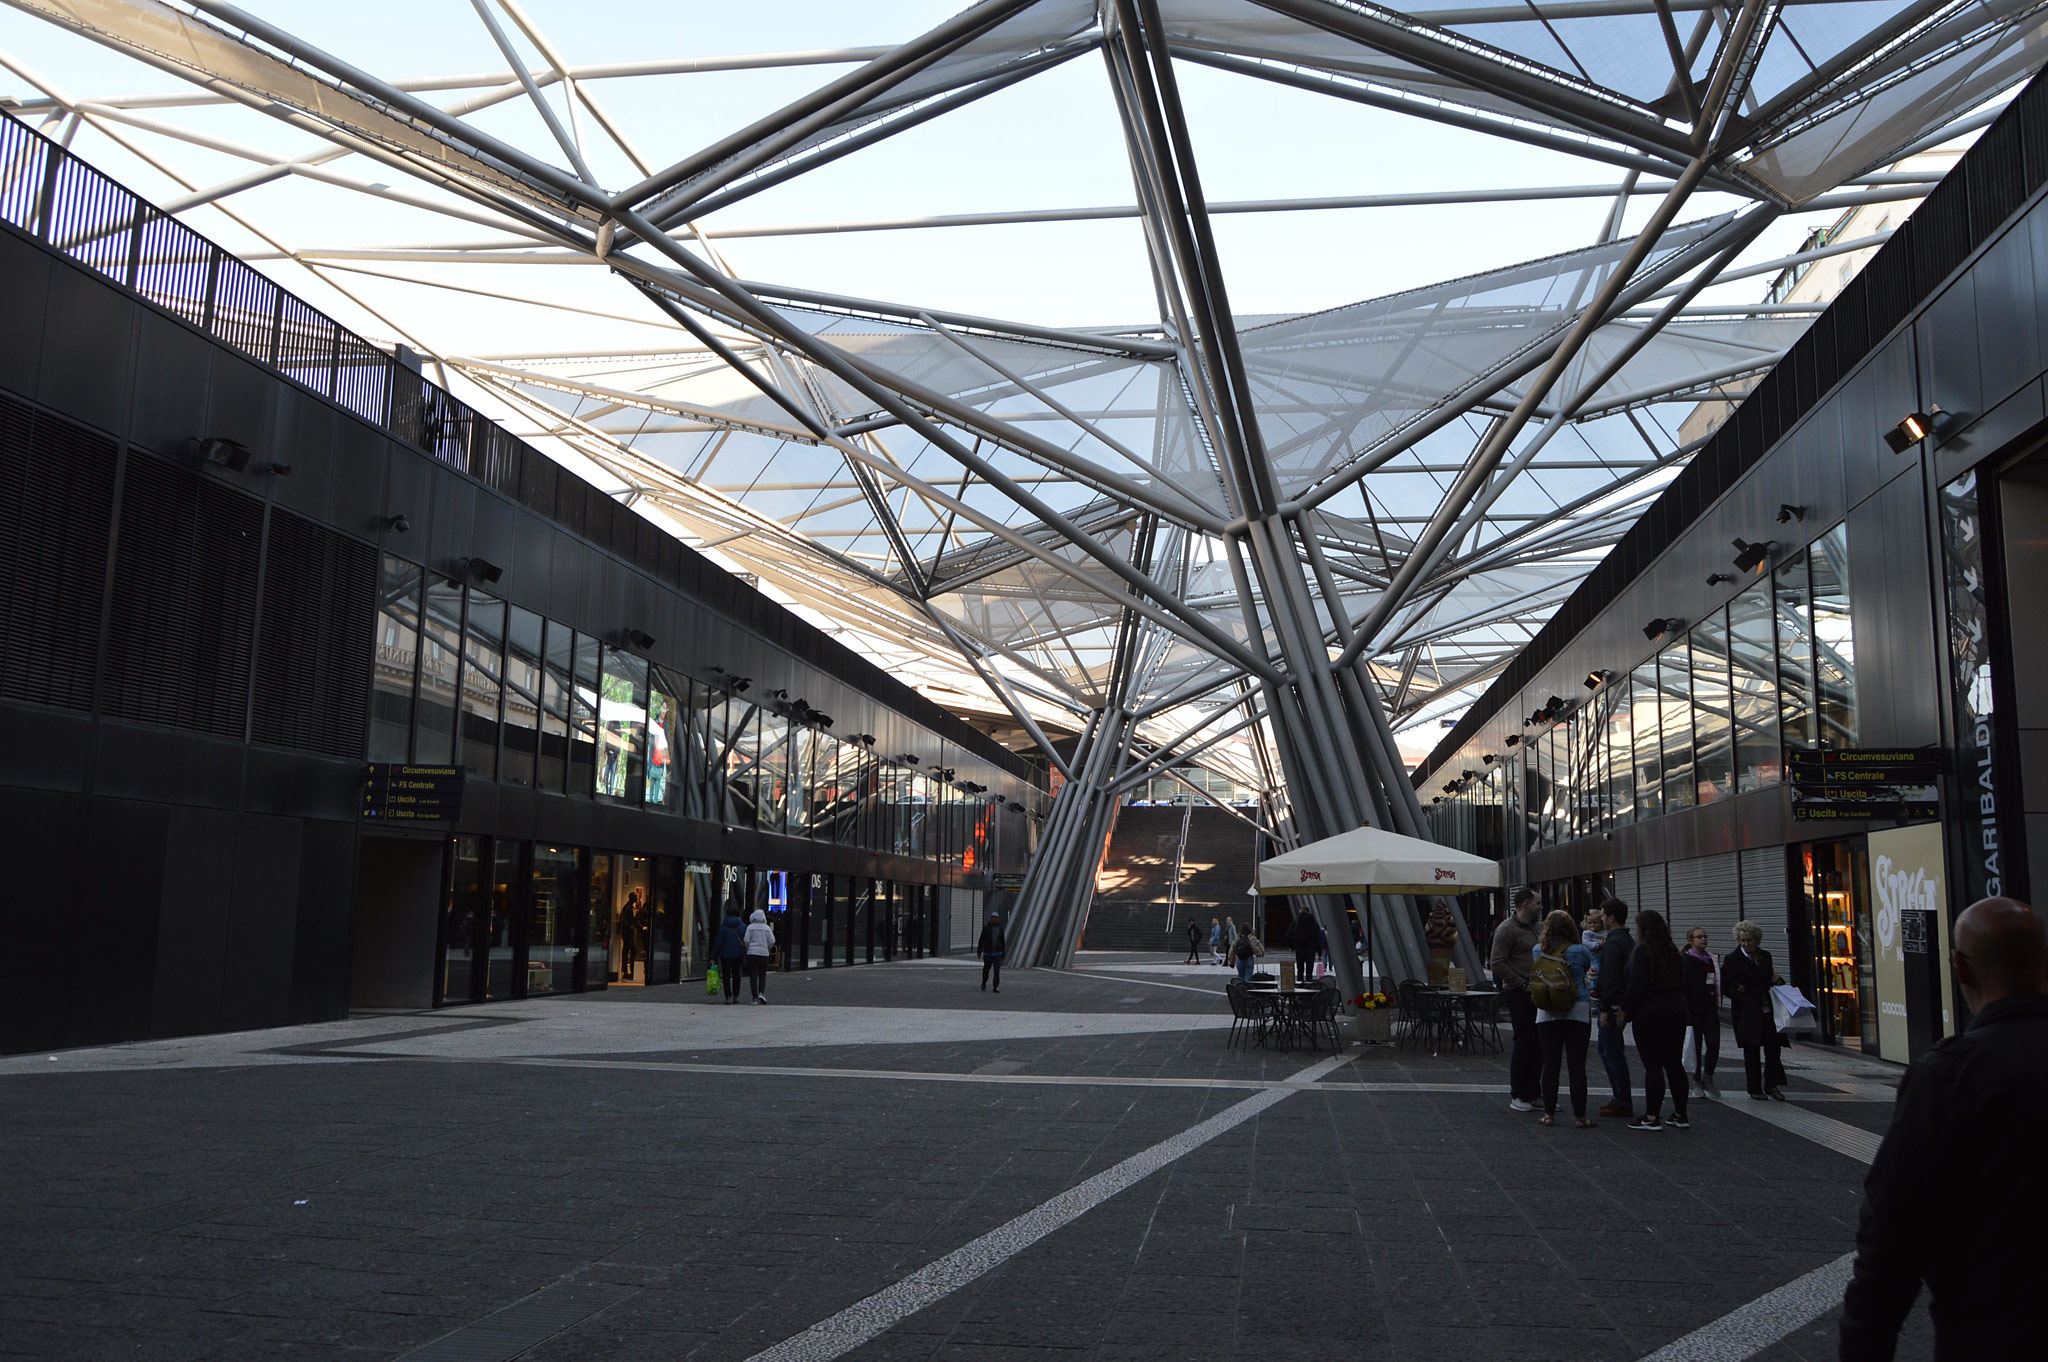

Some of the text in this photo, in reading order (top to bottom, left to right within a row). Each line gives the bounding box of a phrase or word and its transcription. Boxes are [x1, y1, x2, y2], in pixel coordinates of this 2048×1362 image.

[1839, 752, 1915, 761] Circumvesuviana
[402, 766, 456, 775] Circumvesuviana
[1835, 771, 1885, 780] FS Centrale
[399, 780, 435, 790] FS Centrale
[1840, 789, 1867, 798] Uscita
[397, 795, 416, 804] Uscita
[1974, 714, 2001, 899] GARIBALDI
[396, 809, 415, 818] Uscita
[1809, 808, 1837, 818] Uscita
[724, 864, 737, 883] OVS
[811, 873, 821, 889] OVS
